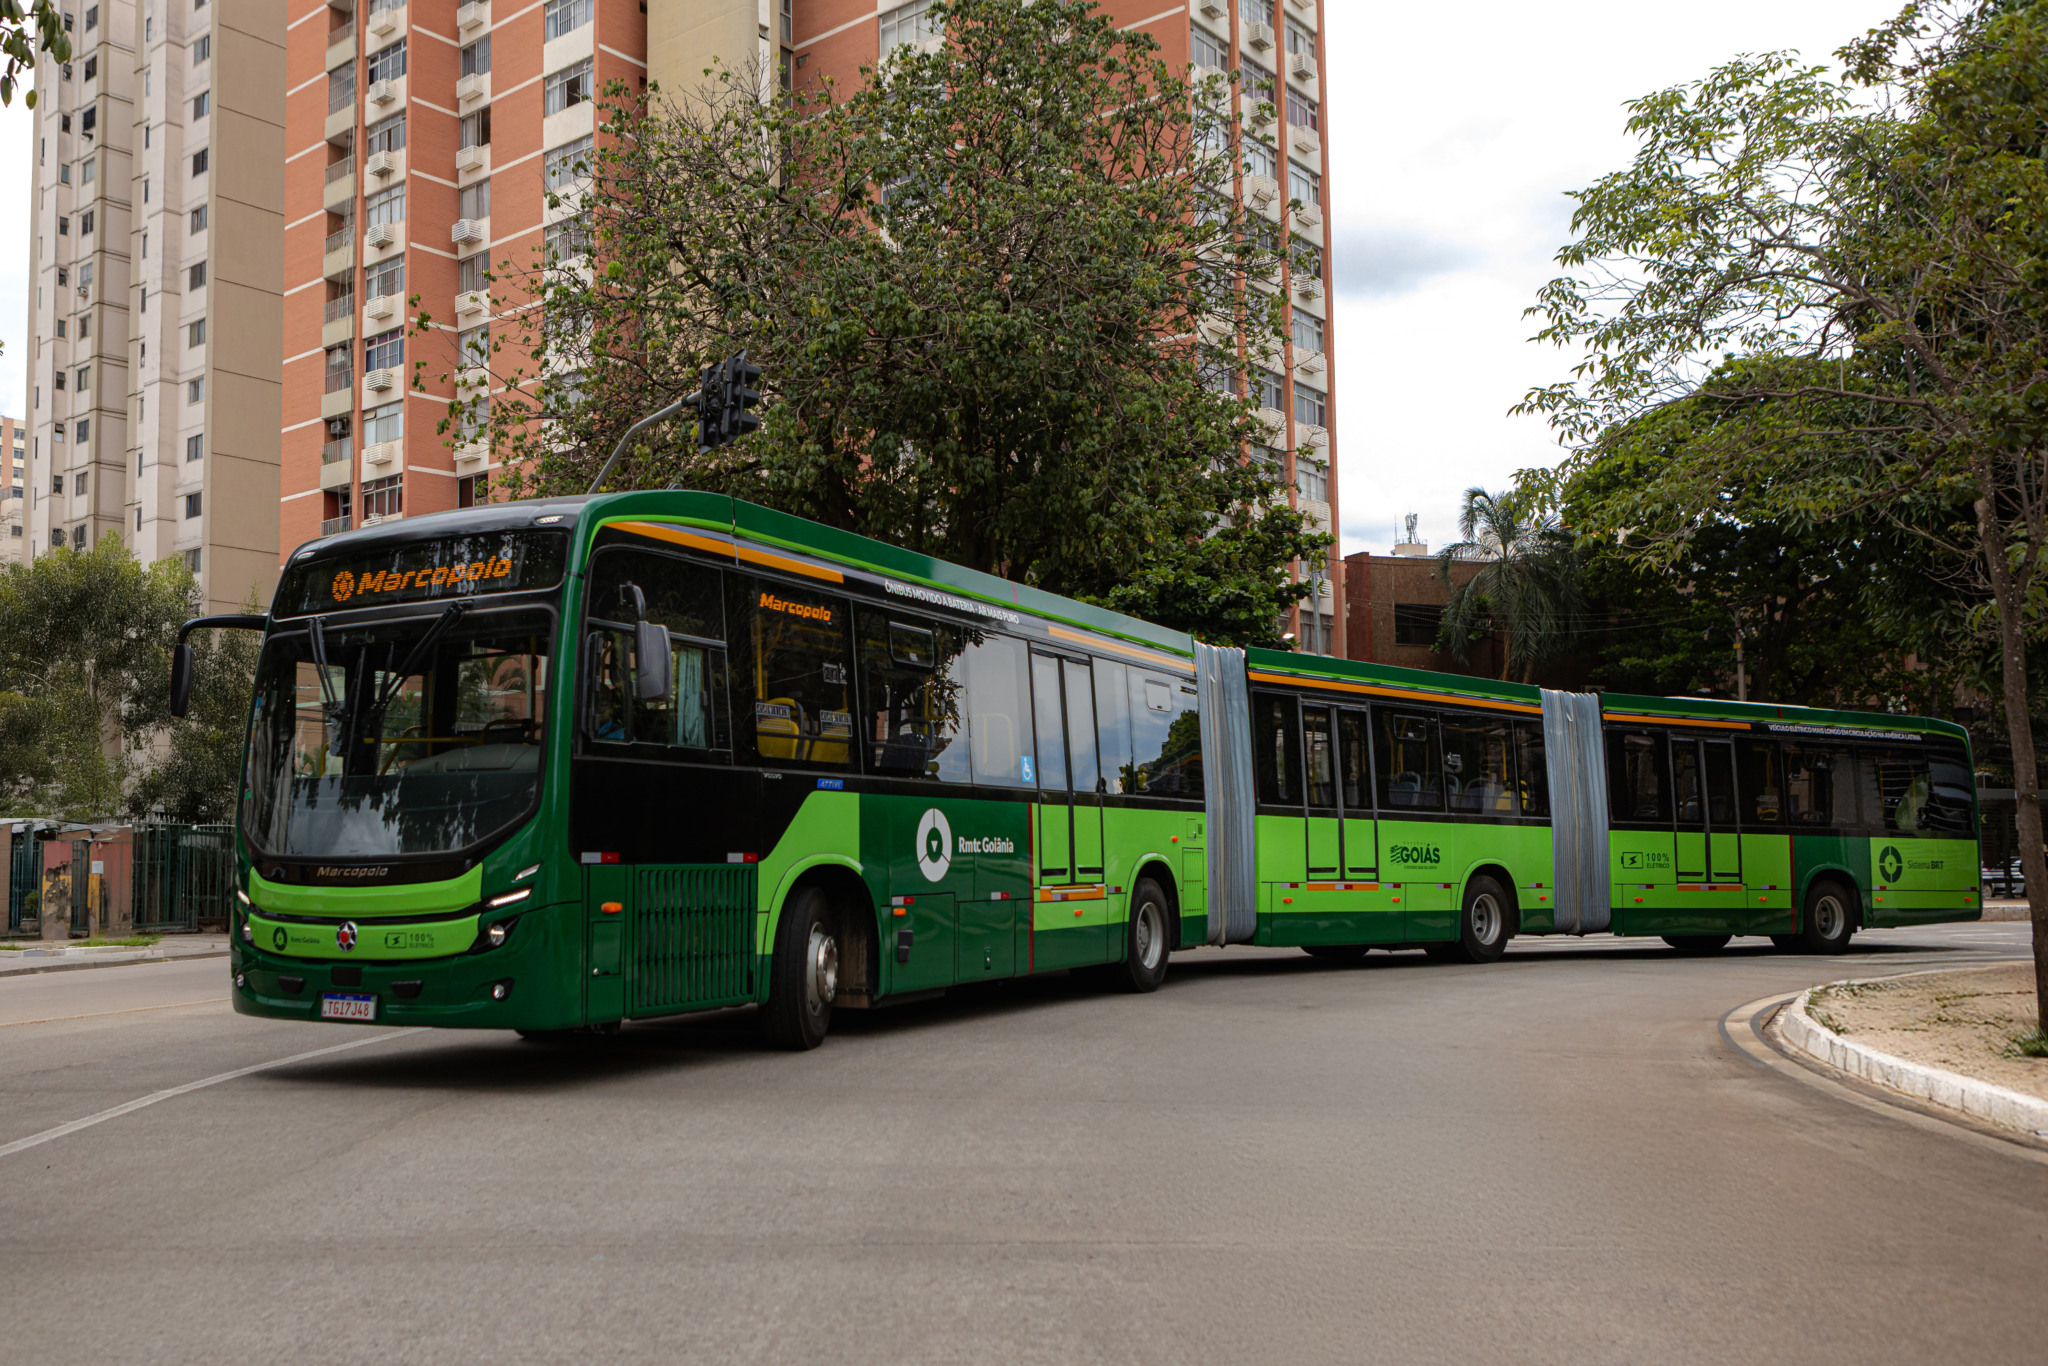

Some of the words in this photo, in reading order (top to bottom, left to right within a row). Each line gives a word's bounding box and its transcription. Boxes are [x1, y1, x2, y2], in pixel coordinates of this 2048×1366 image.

[356, 555, 512, 596] Marcopolo
[759, 592, 832, 622] Marcopolo
[884, 580, 912, 598] ÔNIBUS
[912, 588, 942, 605] MOVIDO
[942, 596, 948, 606] A
[948, 598, 974, 614] BATERIA
[978, 605, 988, 616] AR
[988, 608, 1002, 620] MAIS
[1002, 612, 1020, 624] PURO
[1790, 724, 1812, 733] ELÉTRICO
[958, 836, 981, 853] Rmtc
[982, 836, 1014, 854] Goiânia
[1401, 843, 1440, 864] GOIÁS
[1646, 853, 1669, 861] 100%
[1908, 860, 1930, 869] Sistema
[1931, 860, 1944, 869] BRT
[317, 866, 388, 879] Marcopolo
[409, 934, 434, 942] 100%
